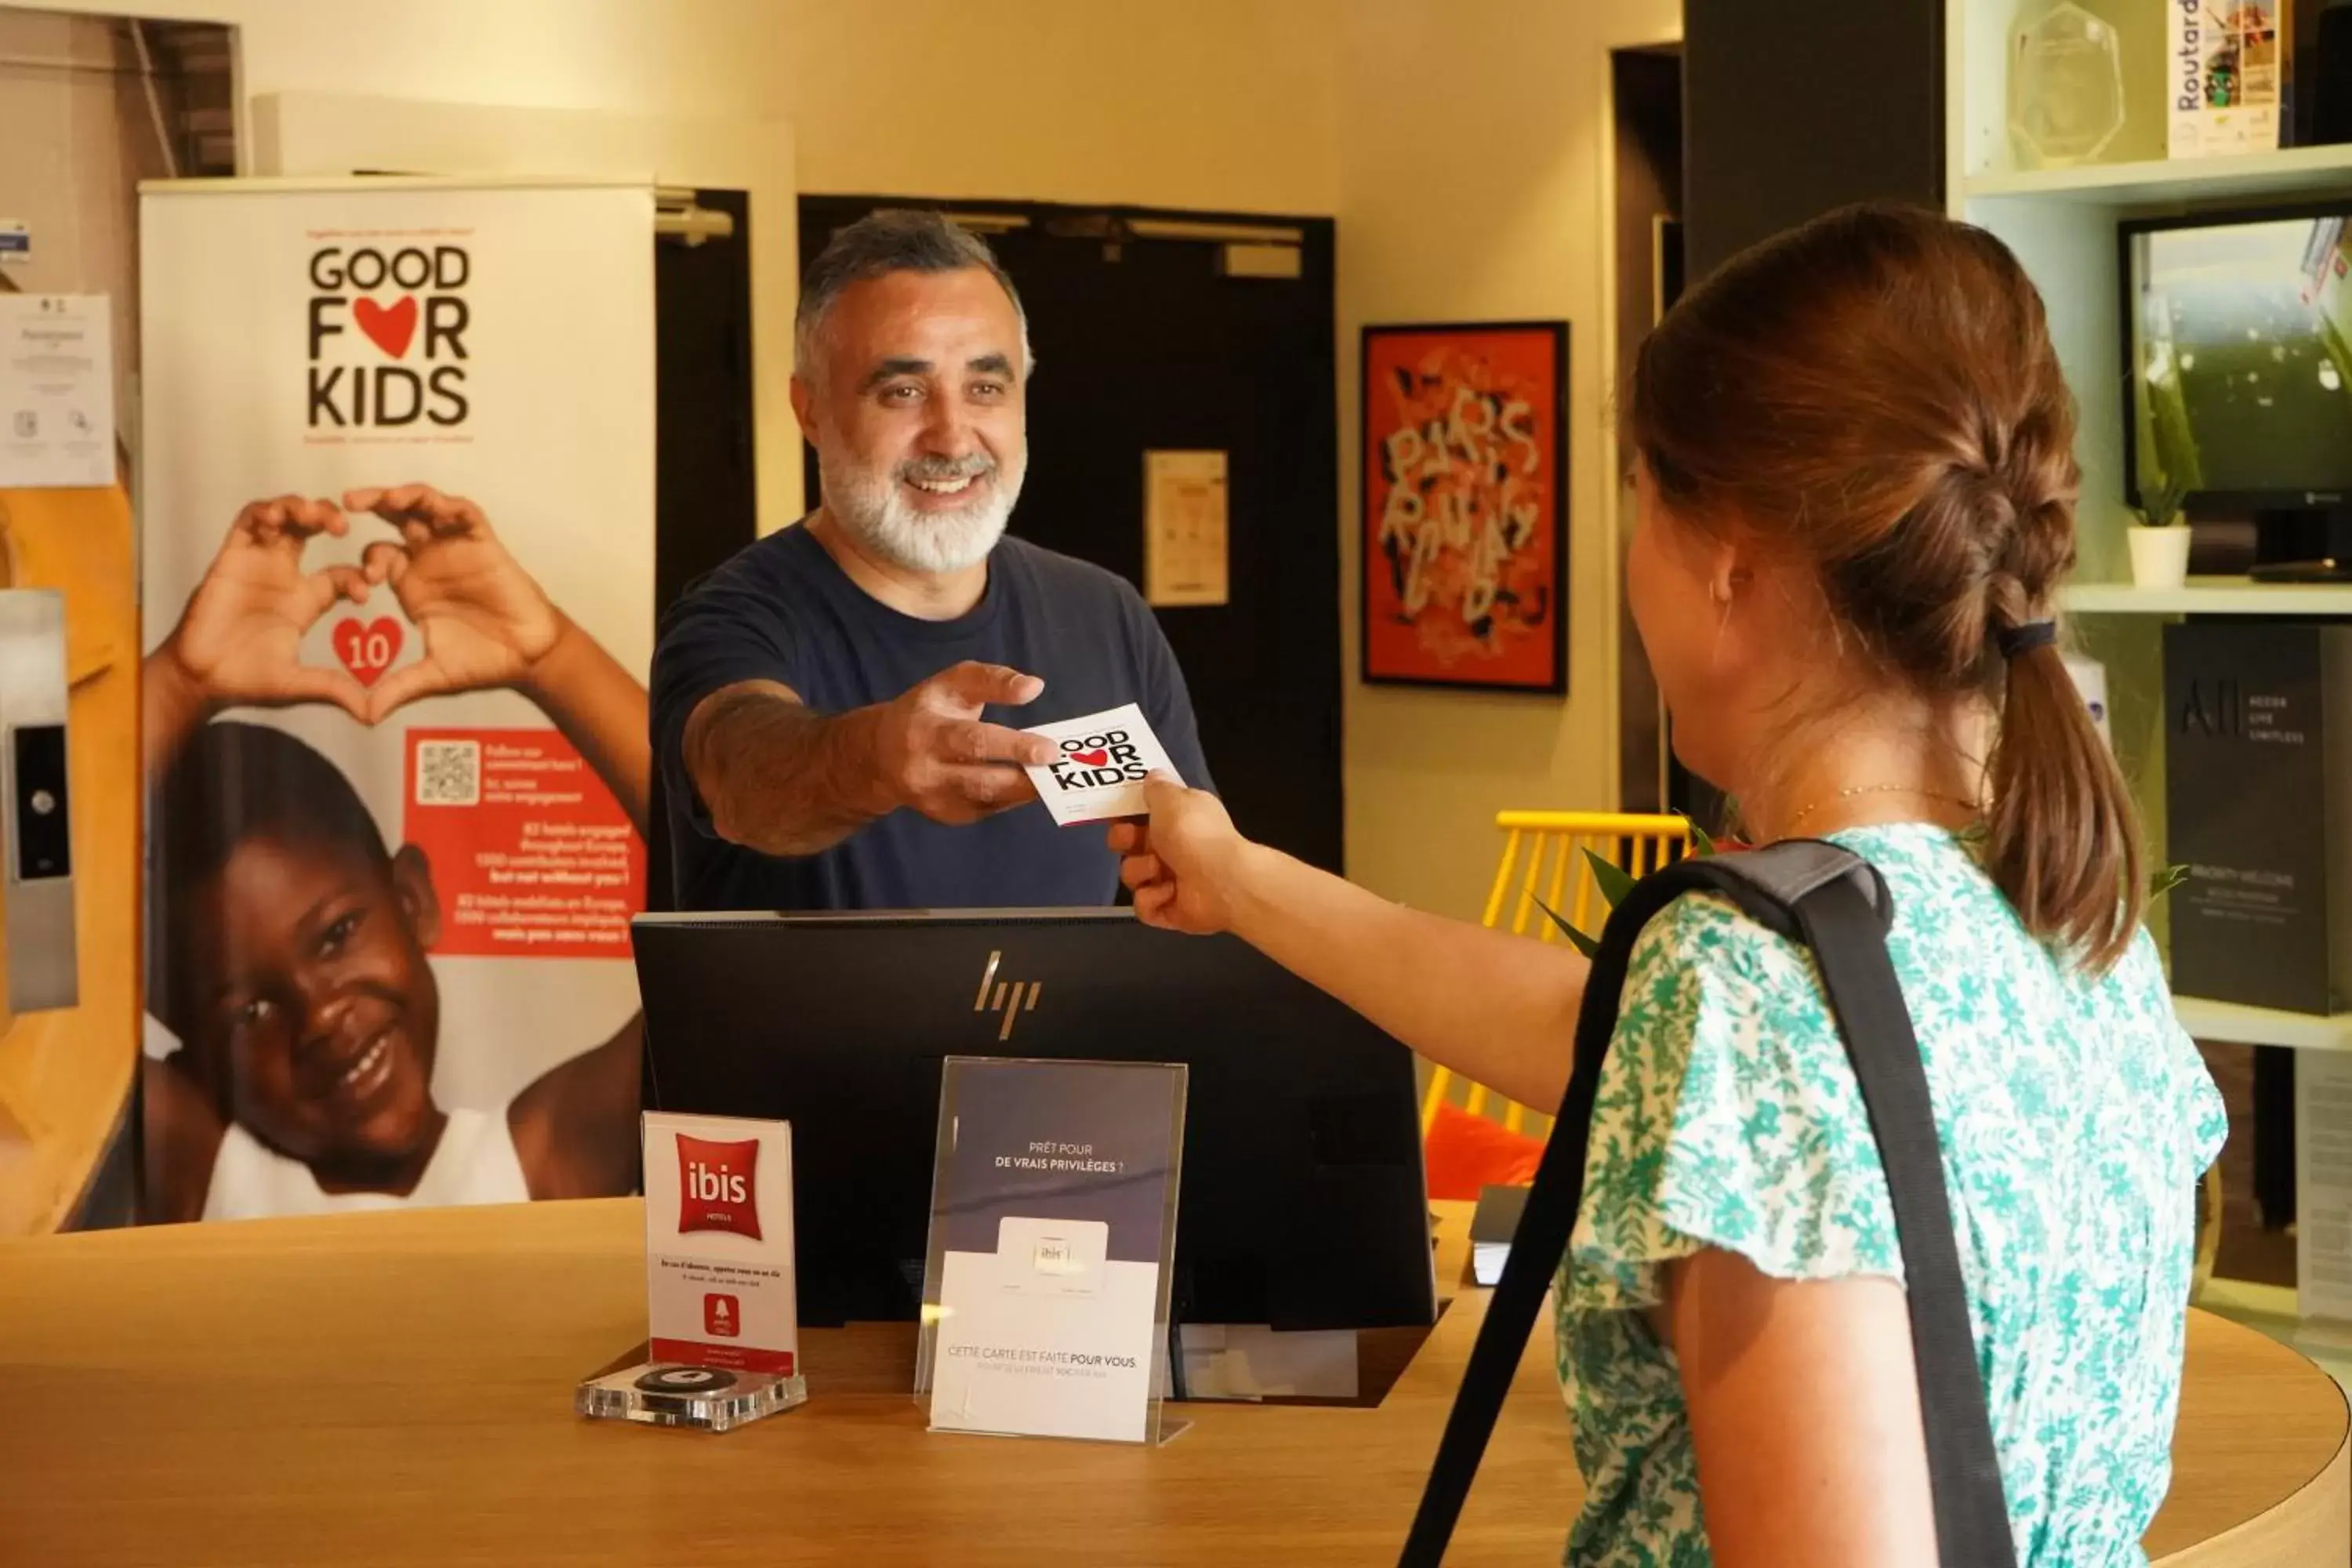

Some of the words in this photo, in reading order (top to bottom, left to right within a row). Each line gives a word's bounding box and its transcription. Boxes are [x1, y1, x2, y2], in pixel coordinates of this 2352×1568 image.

[2178, 0, 2198, 111] Routard
[310, 245, 470, 290] GOOD
[309, 365, 470, 427] KIDS
[348, 633, 390, 669] 10
[1060, 730, 1129, 752] OOD
[1054, 763, 1149, 790] KIDS
[975, 950, 1042, 1041] hp
[995, 1156, 1011, 1167] DE
[1014, 1158, 1047, 1170] VRAIS
[1059, 1143, 1093, 1156] POUR
[689, 1160, 747, 1204] ibis
[948, 1345, 980, 1358] CETTE
[982, 1347, 1018, 1360] CARTE
[1018, 1350, 1038, 1362] EST
[1039, 1352, 1068, 1364] FAITE
[1069, 1354, 1102, 1367] POUR
